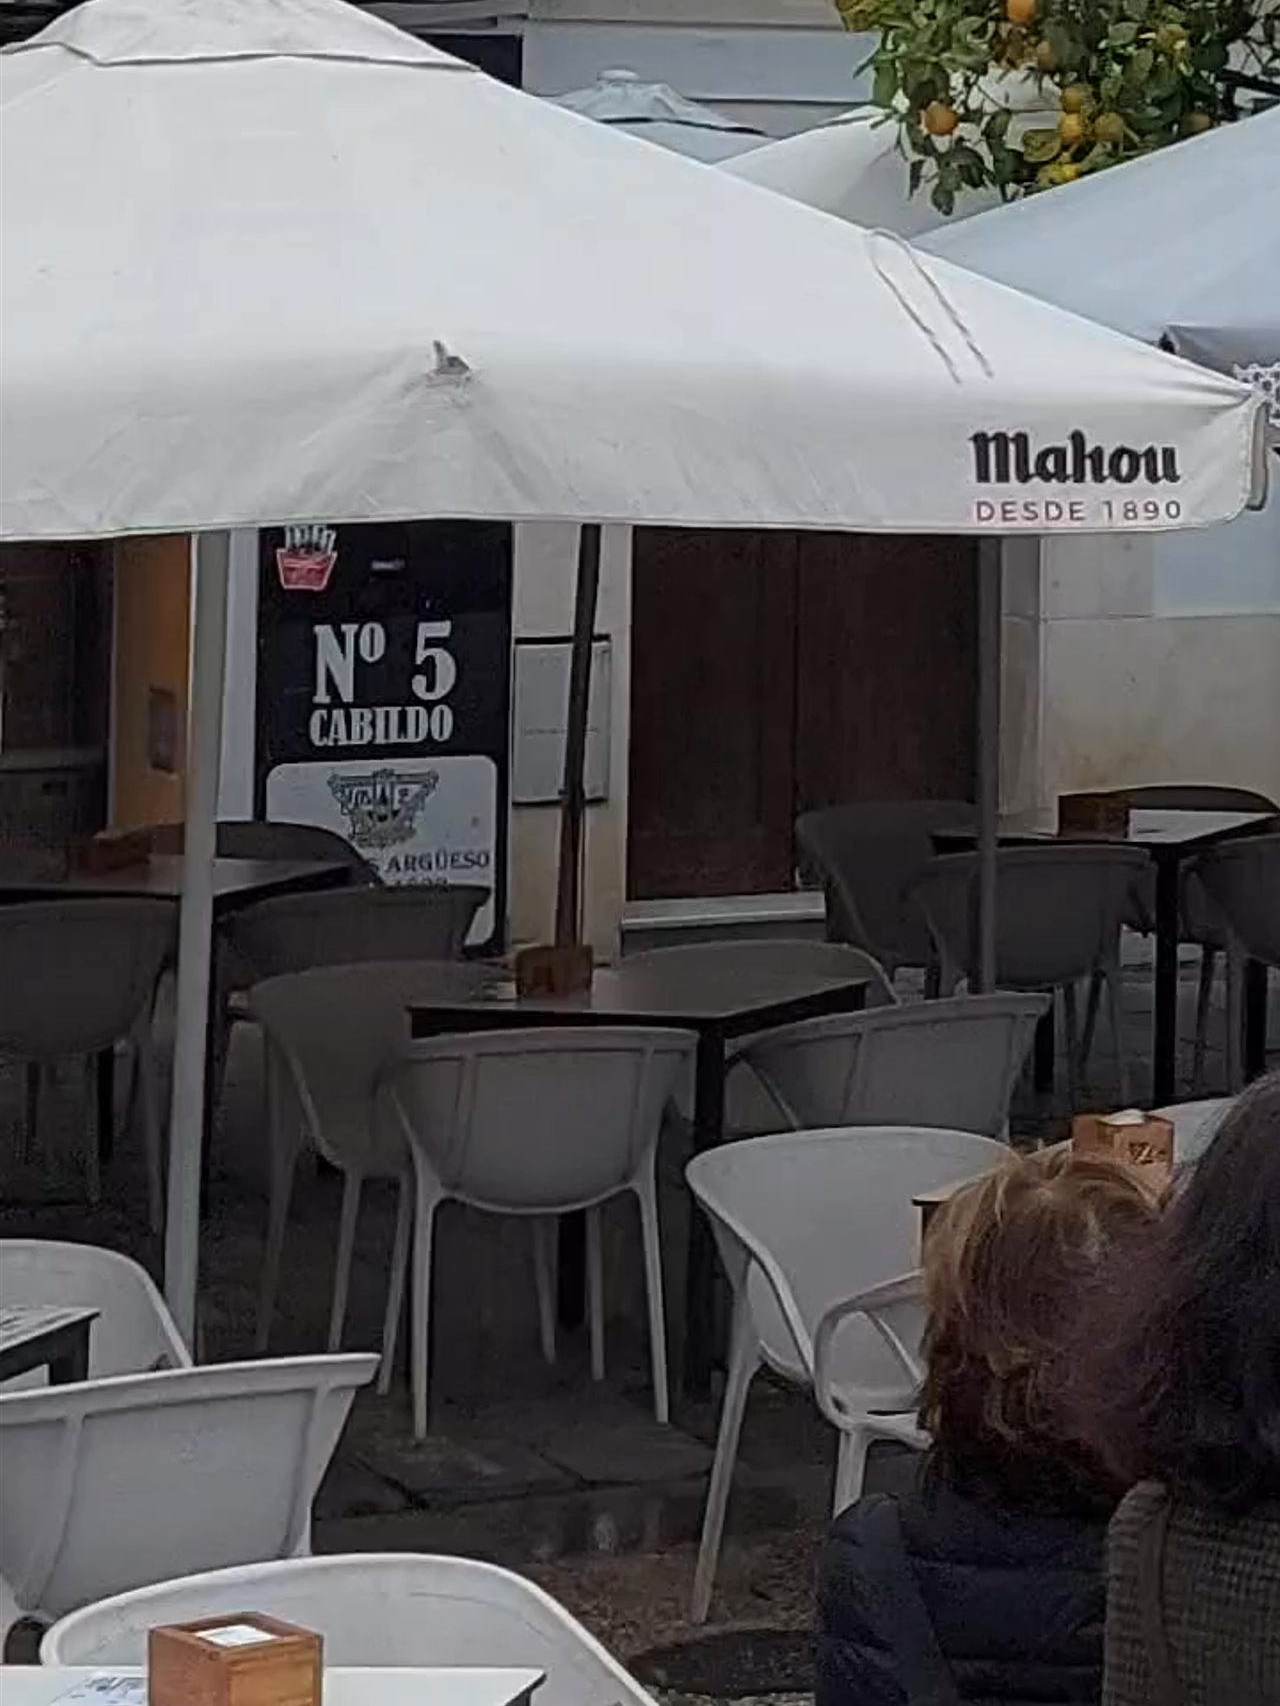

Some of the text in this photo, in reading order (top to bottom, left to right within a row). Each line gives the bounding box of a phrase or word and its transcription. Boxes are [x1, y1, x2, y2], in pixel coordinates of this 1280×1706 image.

[968, 429, 1181, 484] Mahou
[976, 499, 1182, 522] DESDE 1890
[411, 619, 457, 701] 5
[308, 704, 454, 748] CABILDO
[385, 848, 491, 873] ARGÜESO
